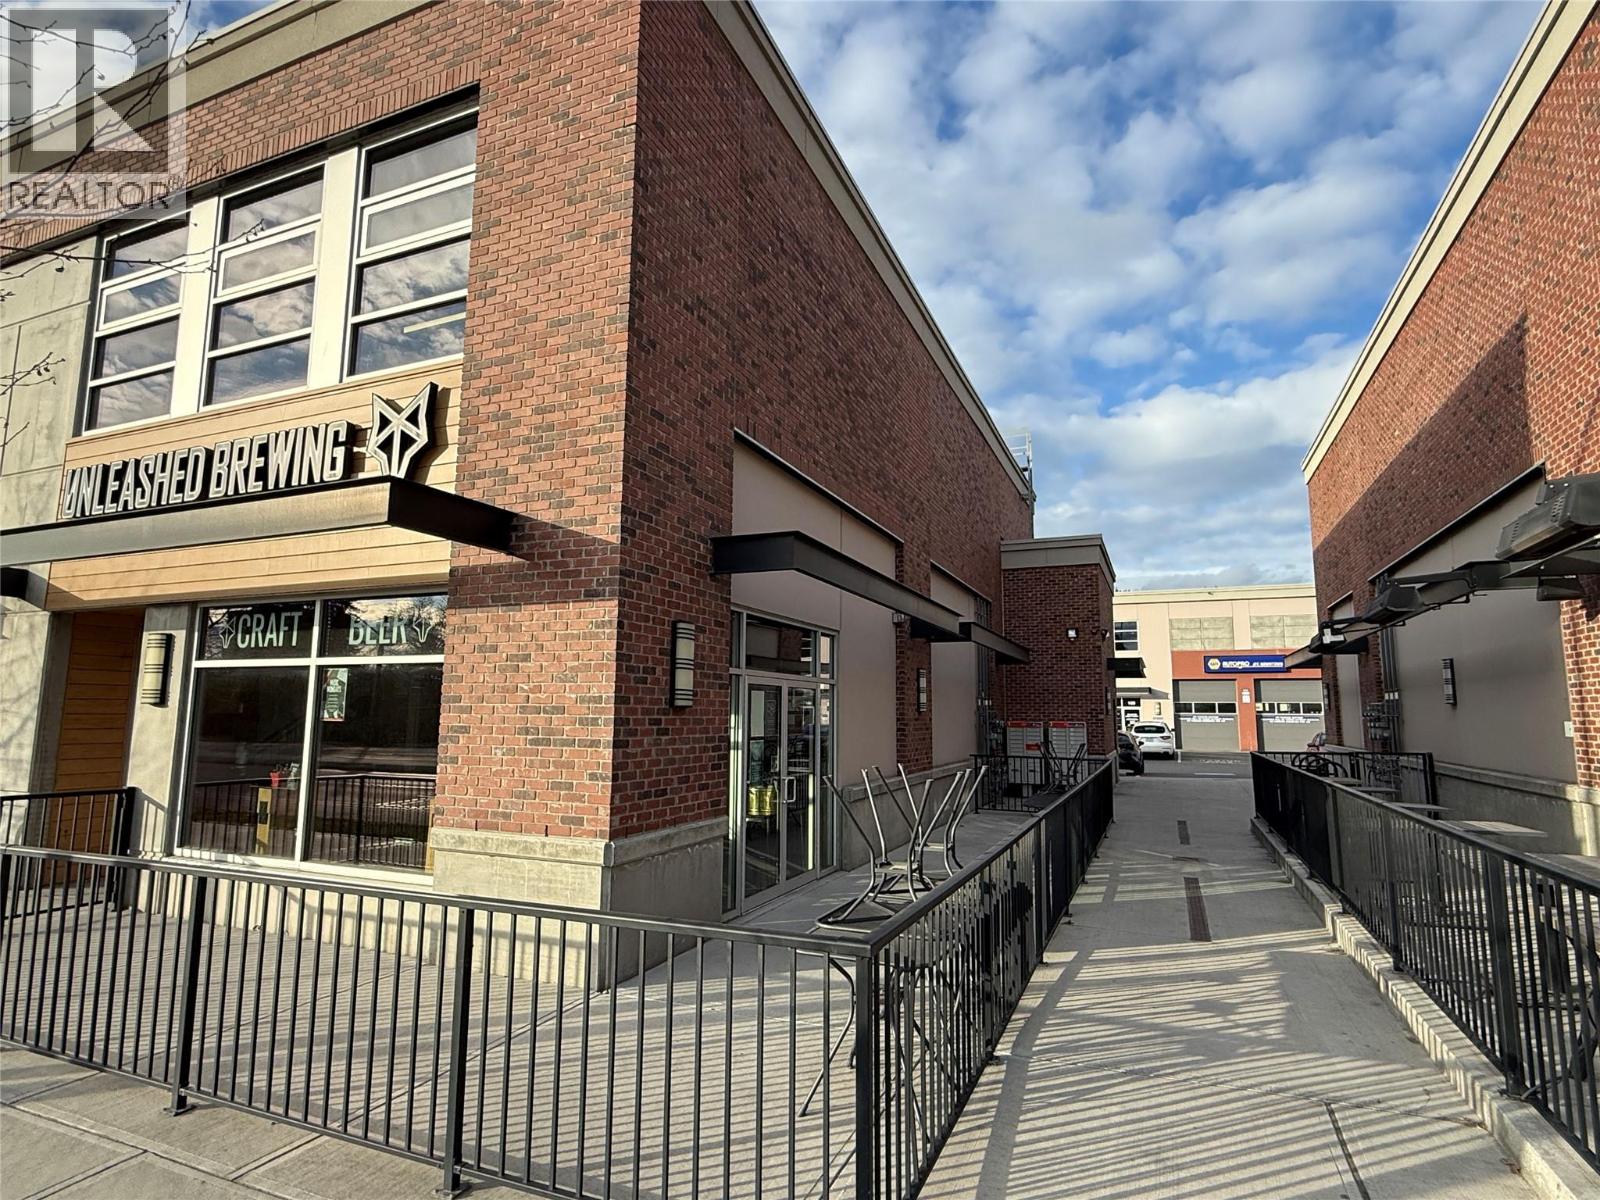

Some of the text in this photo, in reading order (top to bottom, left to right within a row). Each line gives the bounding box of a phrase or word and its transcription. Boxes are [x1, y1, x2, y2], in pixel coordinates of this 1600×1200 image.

[62, 420, 351, 519] UNLEASHED BREWING
[236, 611, 407, 649] CRAFT BEER
